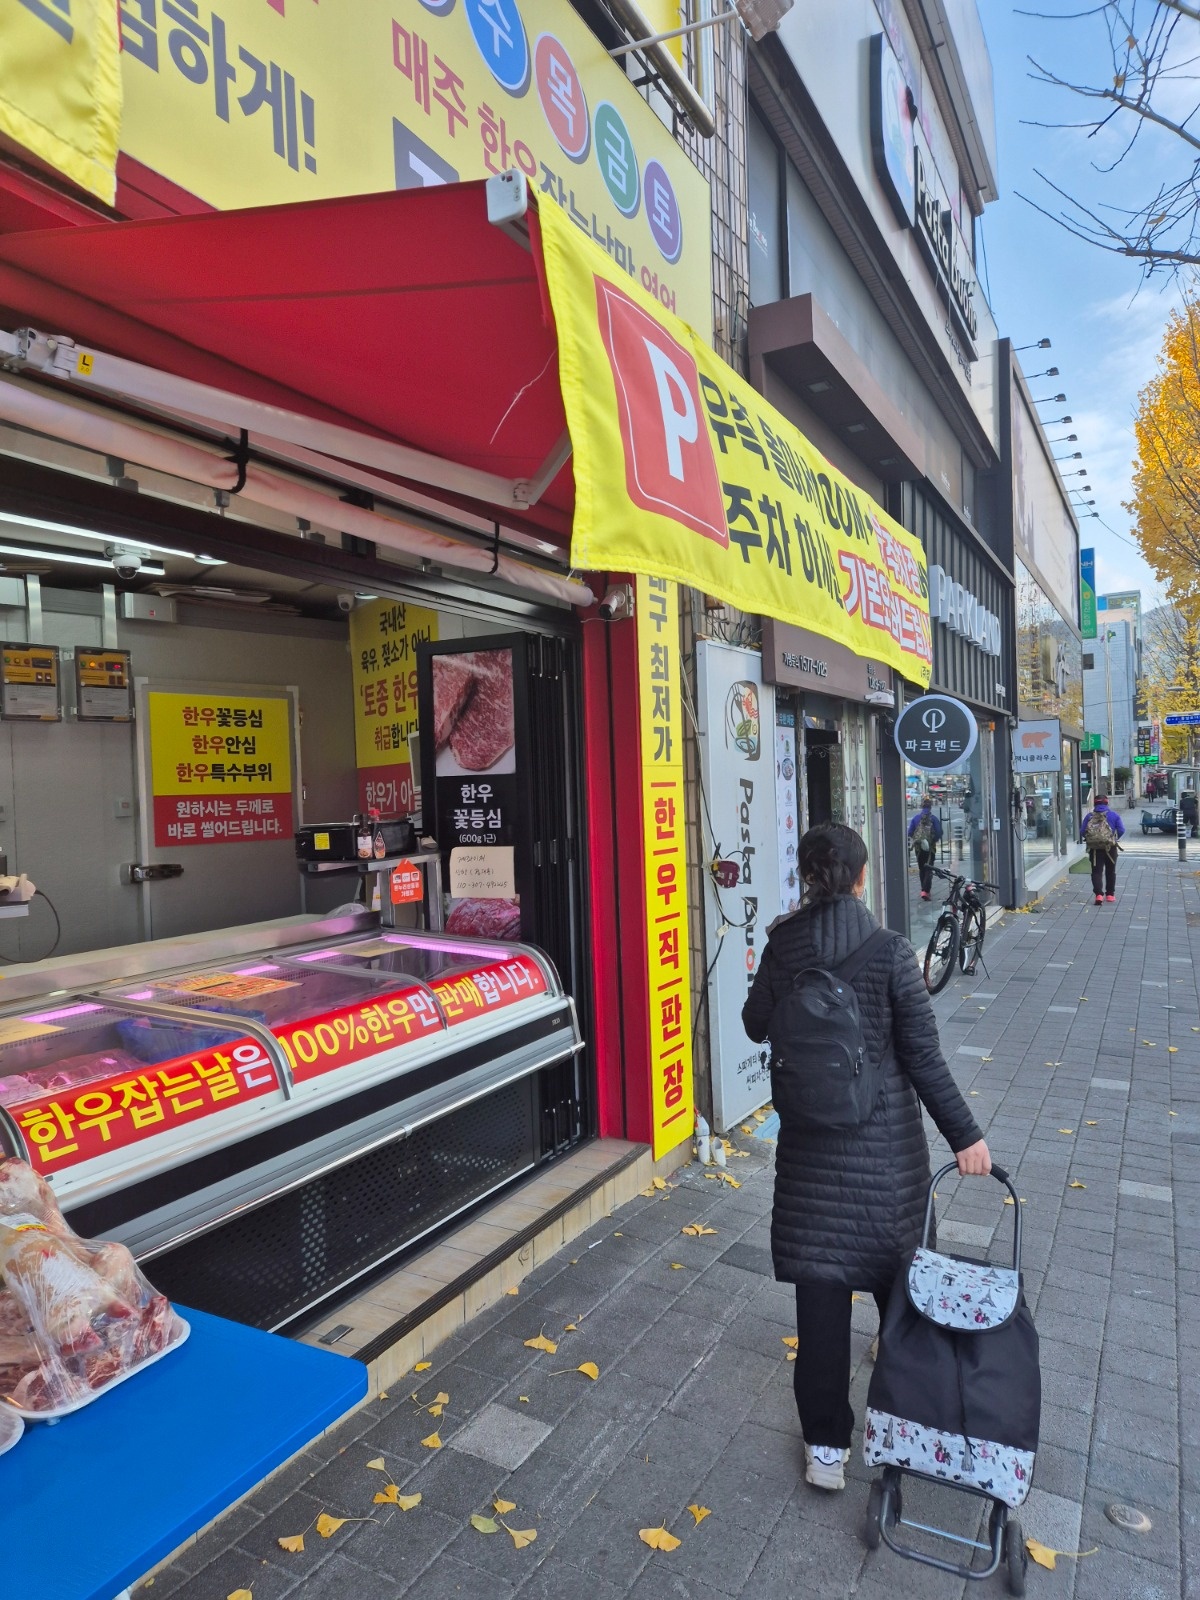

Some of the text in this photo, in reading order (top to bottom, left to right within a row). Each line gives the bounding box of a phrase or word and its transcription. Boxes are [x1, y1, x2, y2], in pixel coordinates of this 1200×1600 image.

[118, 0, 317, 175] 하게!
[391, 17, 469, 139] 매주
[547, 52, 577, 138] 목
[604, 120, 629, 195] 금
[652, 178, 673, 240] 토
[81, 354, 90, 367] L
[641, 335, 699, 483] P
[698, 371, 770, 472] 우측
[721, 480, 792, 577] 주차
[379, 602, 407, 636] 국내산
[929, 564, 1001, 657] PARKLAND
[361, 649, 380, 674] 육우,
[381, 635, 409, 668] 젖소가
[182, 706, 263, 728] 한우꽃등심
[650, 641, 672, 762] 최저가
[191, 735, 256, 755] 한우안심
[905, 738, 962, 753] 파크랜드
[175, 762, 273, 783] 한우특수부위
[365, 779, 398, 814] 한우가
[460, 783, 494, 804] 한우
[167, 818, 283, 839] 바로 썰어드립니다.
[176, 799, 274, 818] 원하시는 두께로
[453, 808, 502, 829] 꽃등심
[739, 778, 755, 885] Pasta
[20, 1043, 273, 1163] 한우잡는날은
[436, 960, 541, 1020] 판매합니다.
